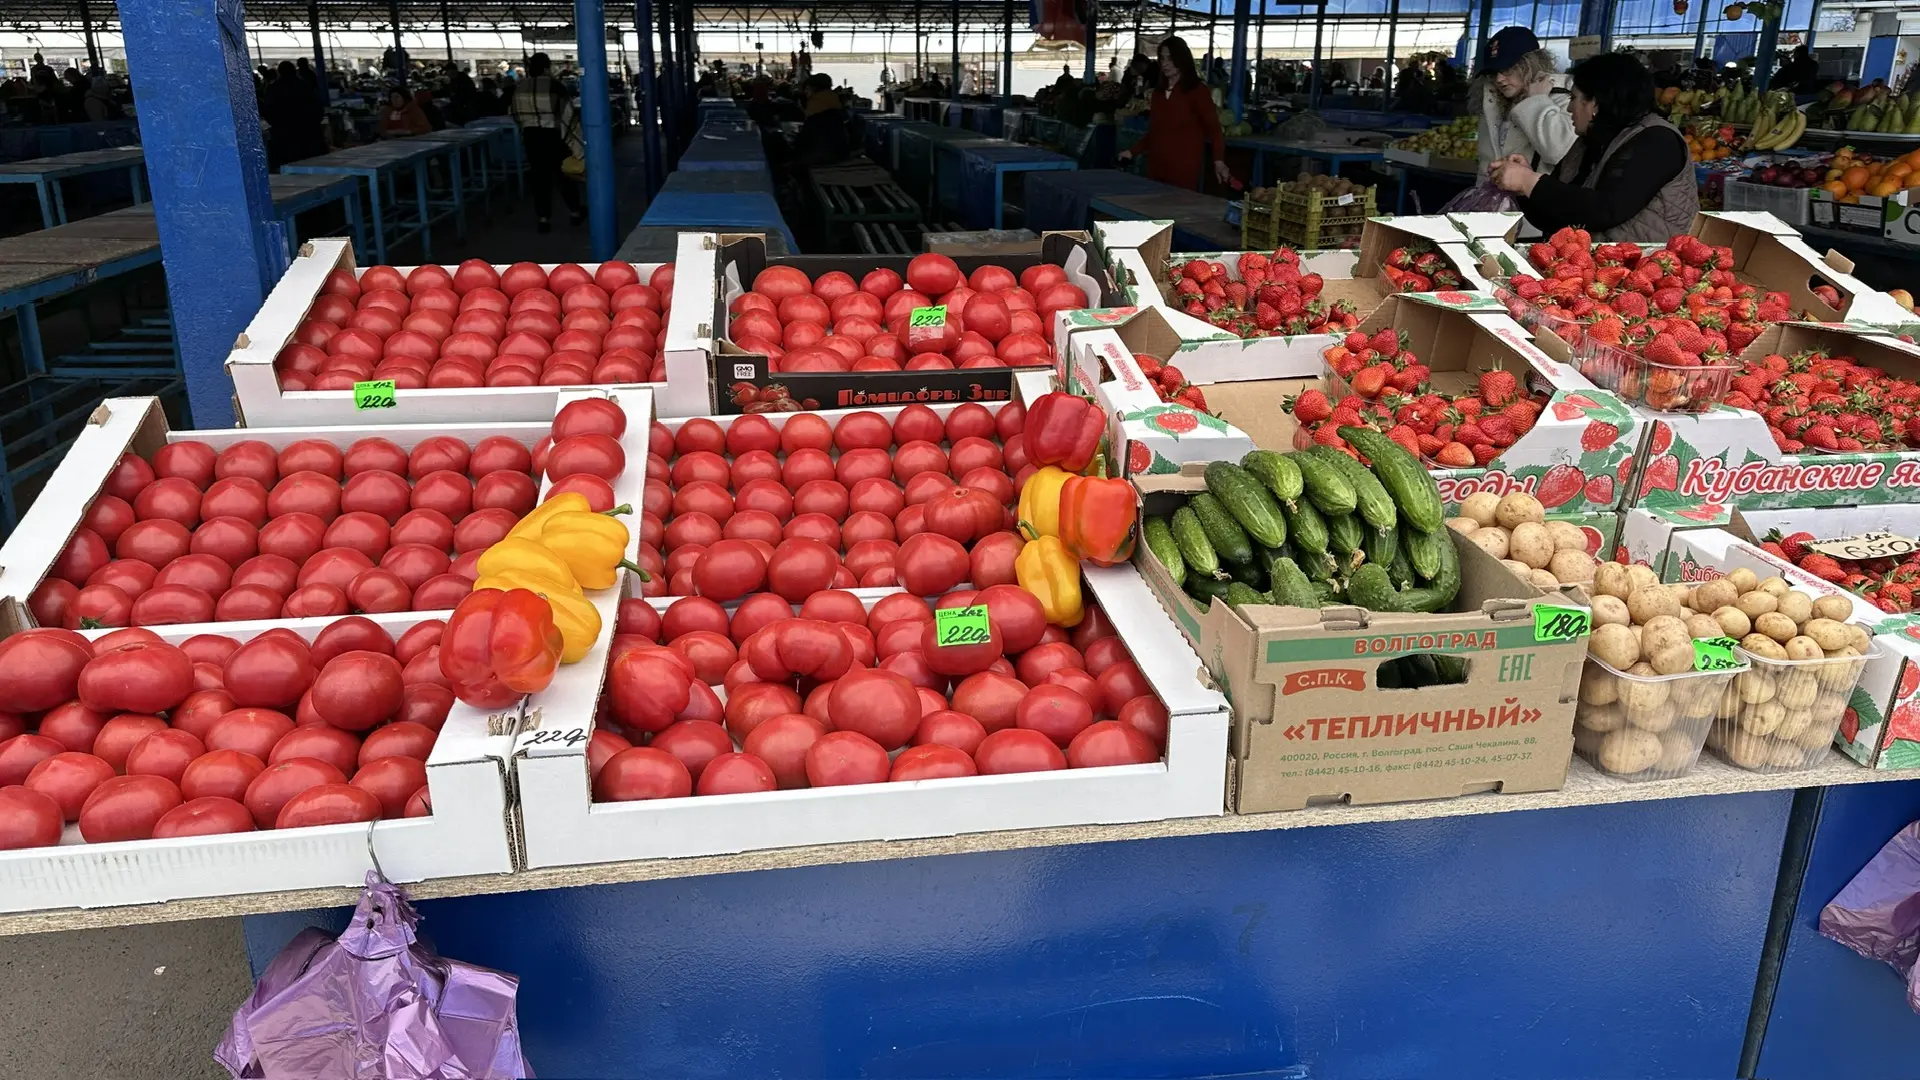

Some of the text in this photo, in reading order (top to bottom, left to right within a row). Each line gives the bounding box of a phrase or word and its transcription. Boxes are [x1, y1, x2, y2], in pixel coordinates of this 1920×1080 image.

[1436, 470, 1537, 504] годы
[1681, 457, 1885, 504] Кубанские
[1354, 631, 1498, 654] ВОЛГОГРАД
[1297, 671, 1353, 688] С.П.К.
[1282, 697, 1542, 741] «ТЕПЛИЧНЫЙ»
[1280, 752, 1320, 762] 400020,
[1323, 751, 1360, 760] Россия,
[1362, 750, 1369, 758] г.
[1425, 745, 1446, 753] пос.
[1448, 743, 1474, 751] Саши
[1476, 738, 1521, 749] Чекалина,
[1304, 766, 1336, 777] (8442)
[1338, 765, 1383, 774] 45-10-16,
[1413, 759, 1443, 770] (8442)
[1445, 756, 1489, 766] 45-10-24,
